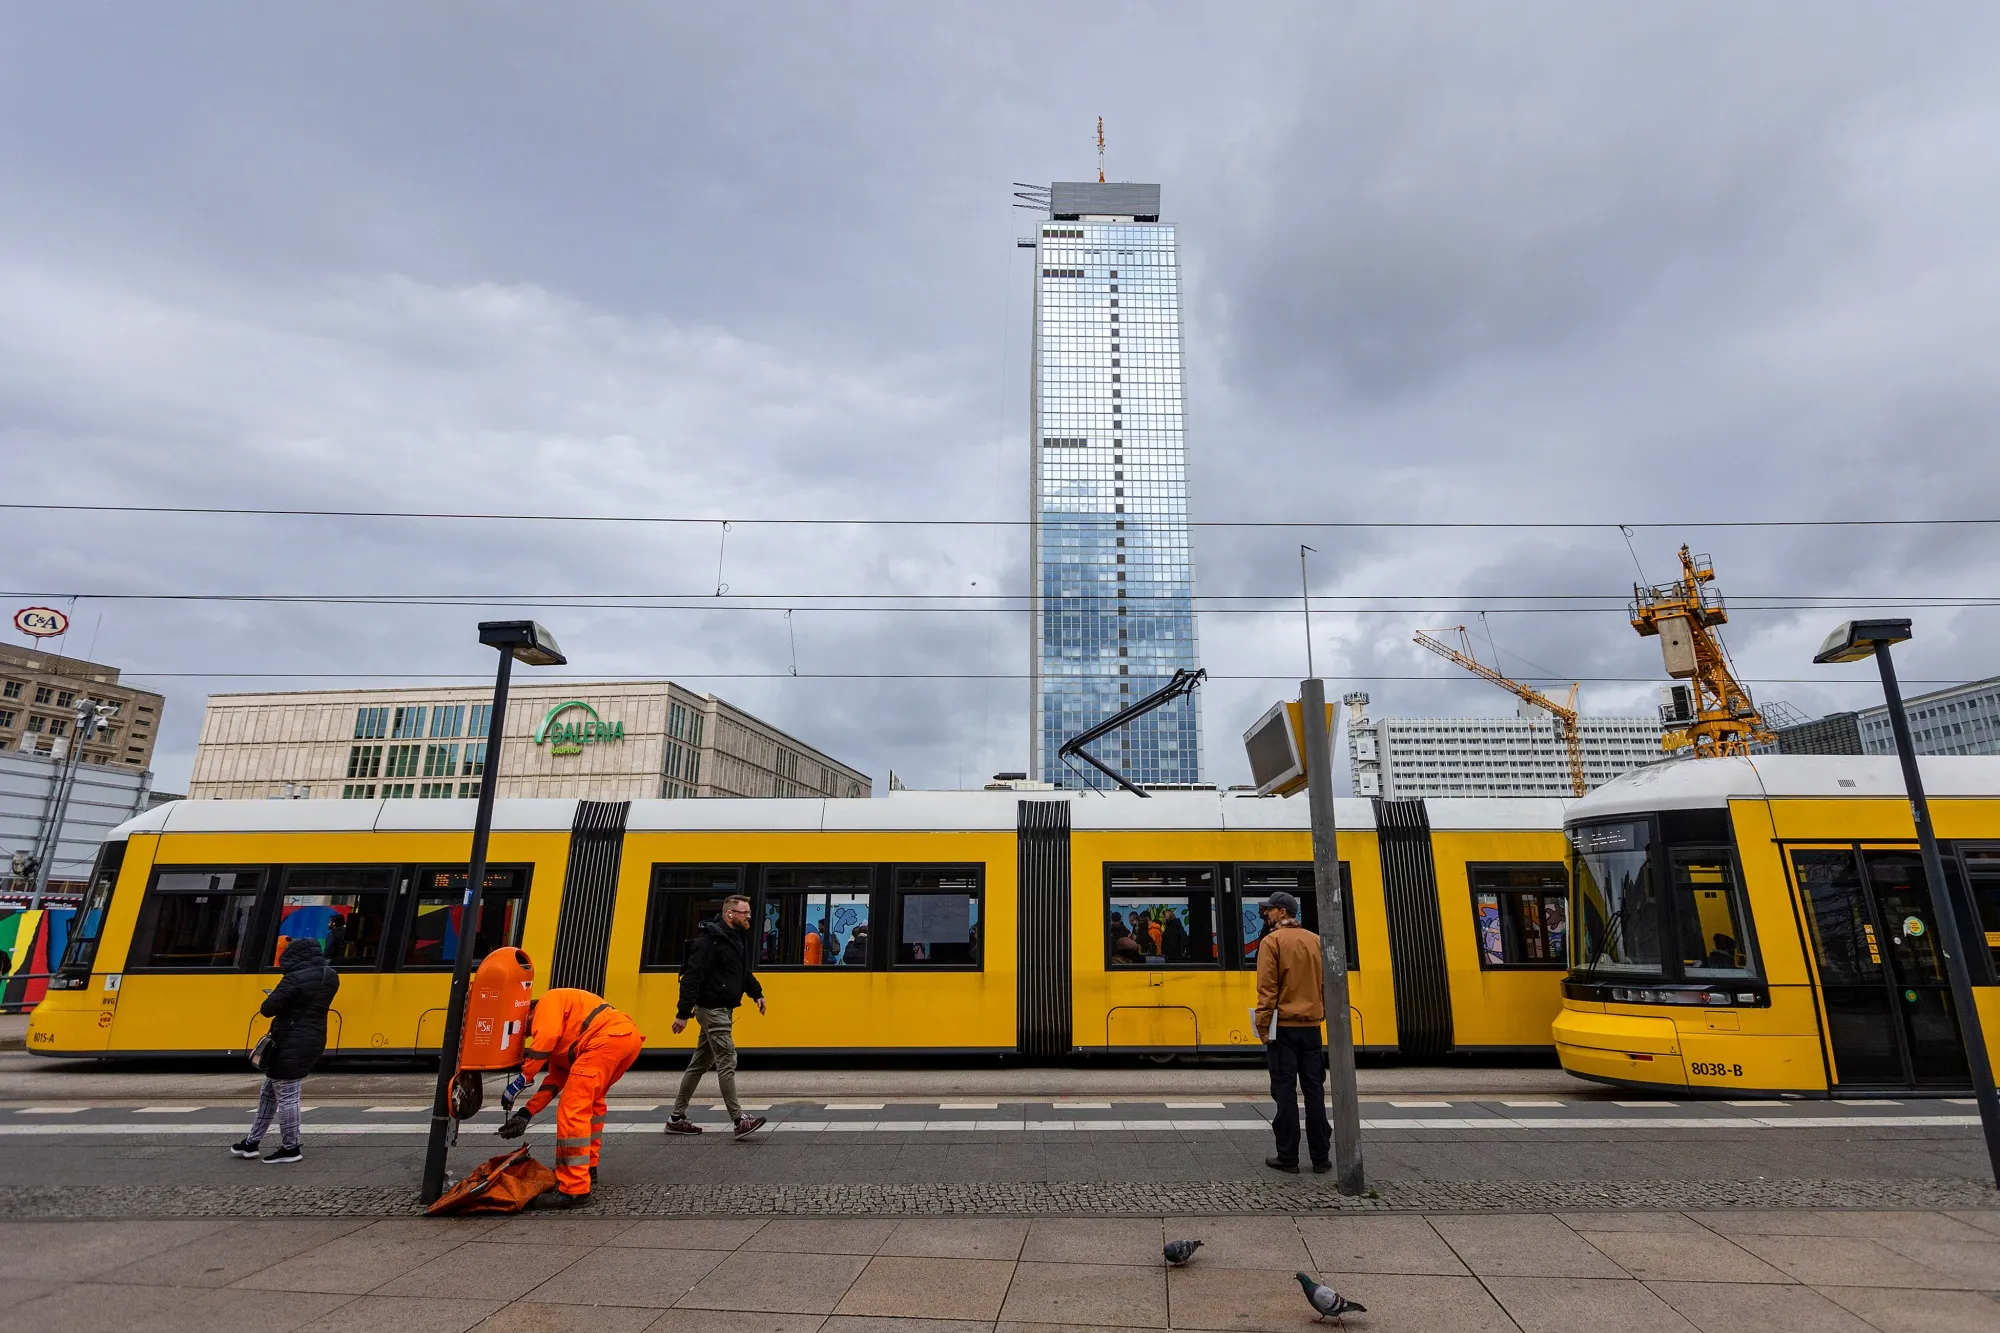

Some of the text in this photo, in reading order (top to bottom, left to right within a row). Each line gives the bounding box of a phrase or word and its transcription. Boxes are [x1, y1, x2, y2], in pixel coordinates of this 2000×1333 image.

[23, 612, 59, 630] C&A
[550, 720, 625, 744] GALERIA
[102, 997, 116, 1005] BVG
[477, 1020, 491, 1032] BSR
[33, 1032, 55, 1044] 8015-A
[1691, 1062, 1743, 1077] 8038-B
